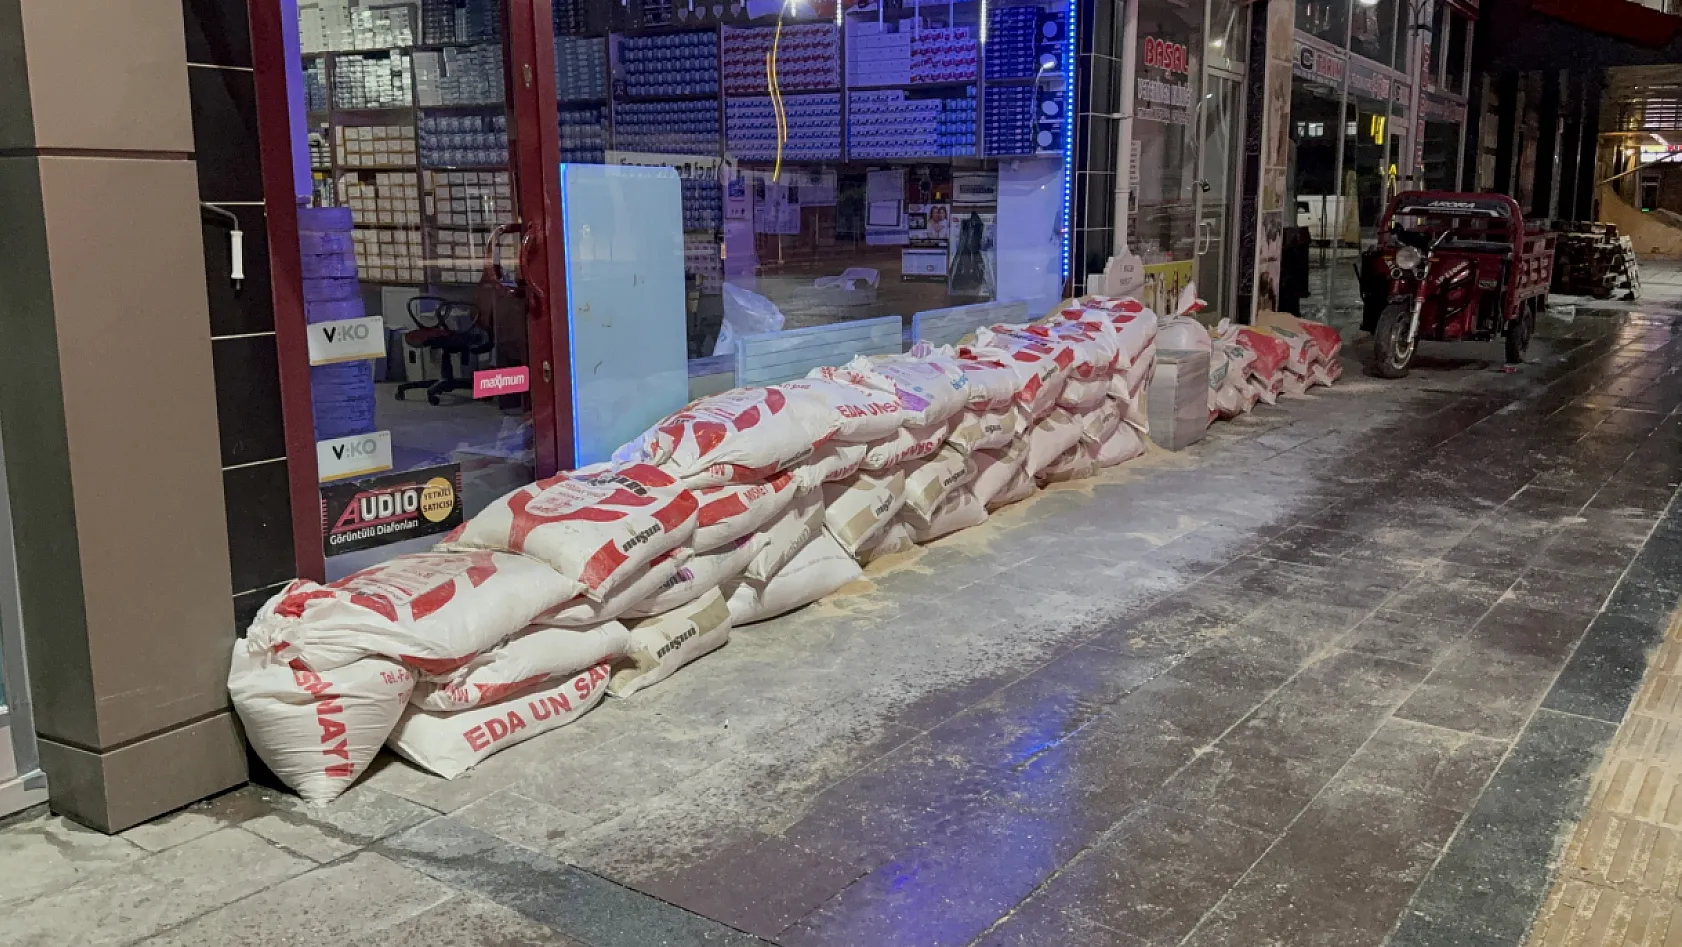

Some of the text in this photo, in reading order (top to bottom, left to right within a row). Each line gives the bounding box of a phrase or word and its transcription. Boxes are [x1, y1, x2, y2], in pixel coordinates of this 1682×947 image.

[330, 485, 418, 534] AUDIO
[330, 525, 376, 545] Görüntülü
[463, 710, 527, 752] EDA
[528, 692, 573, 721] UN
